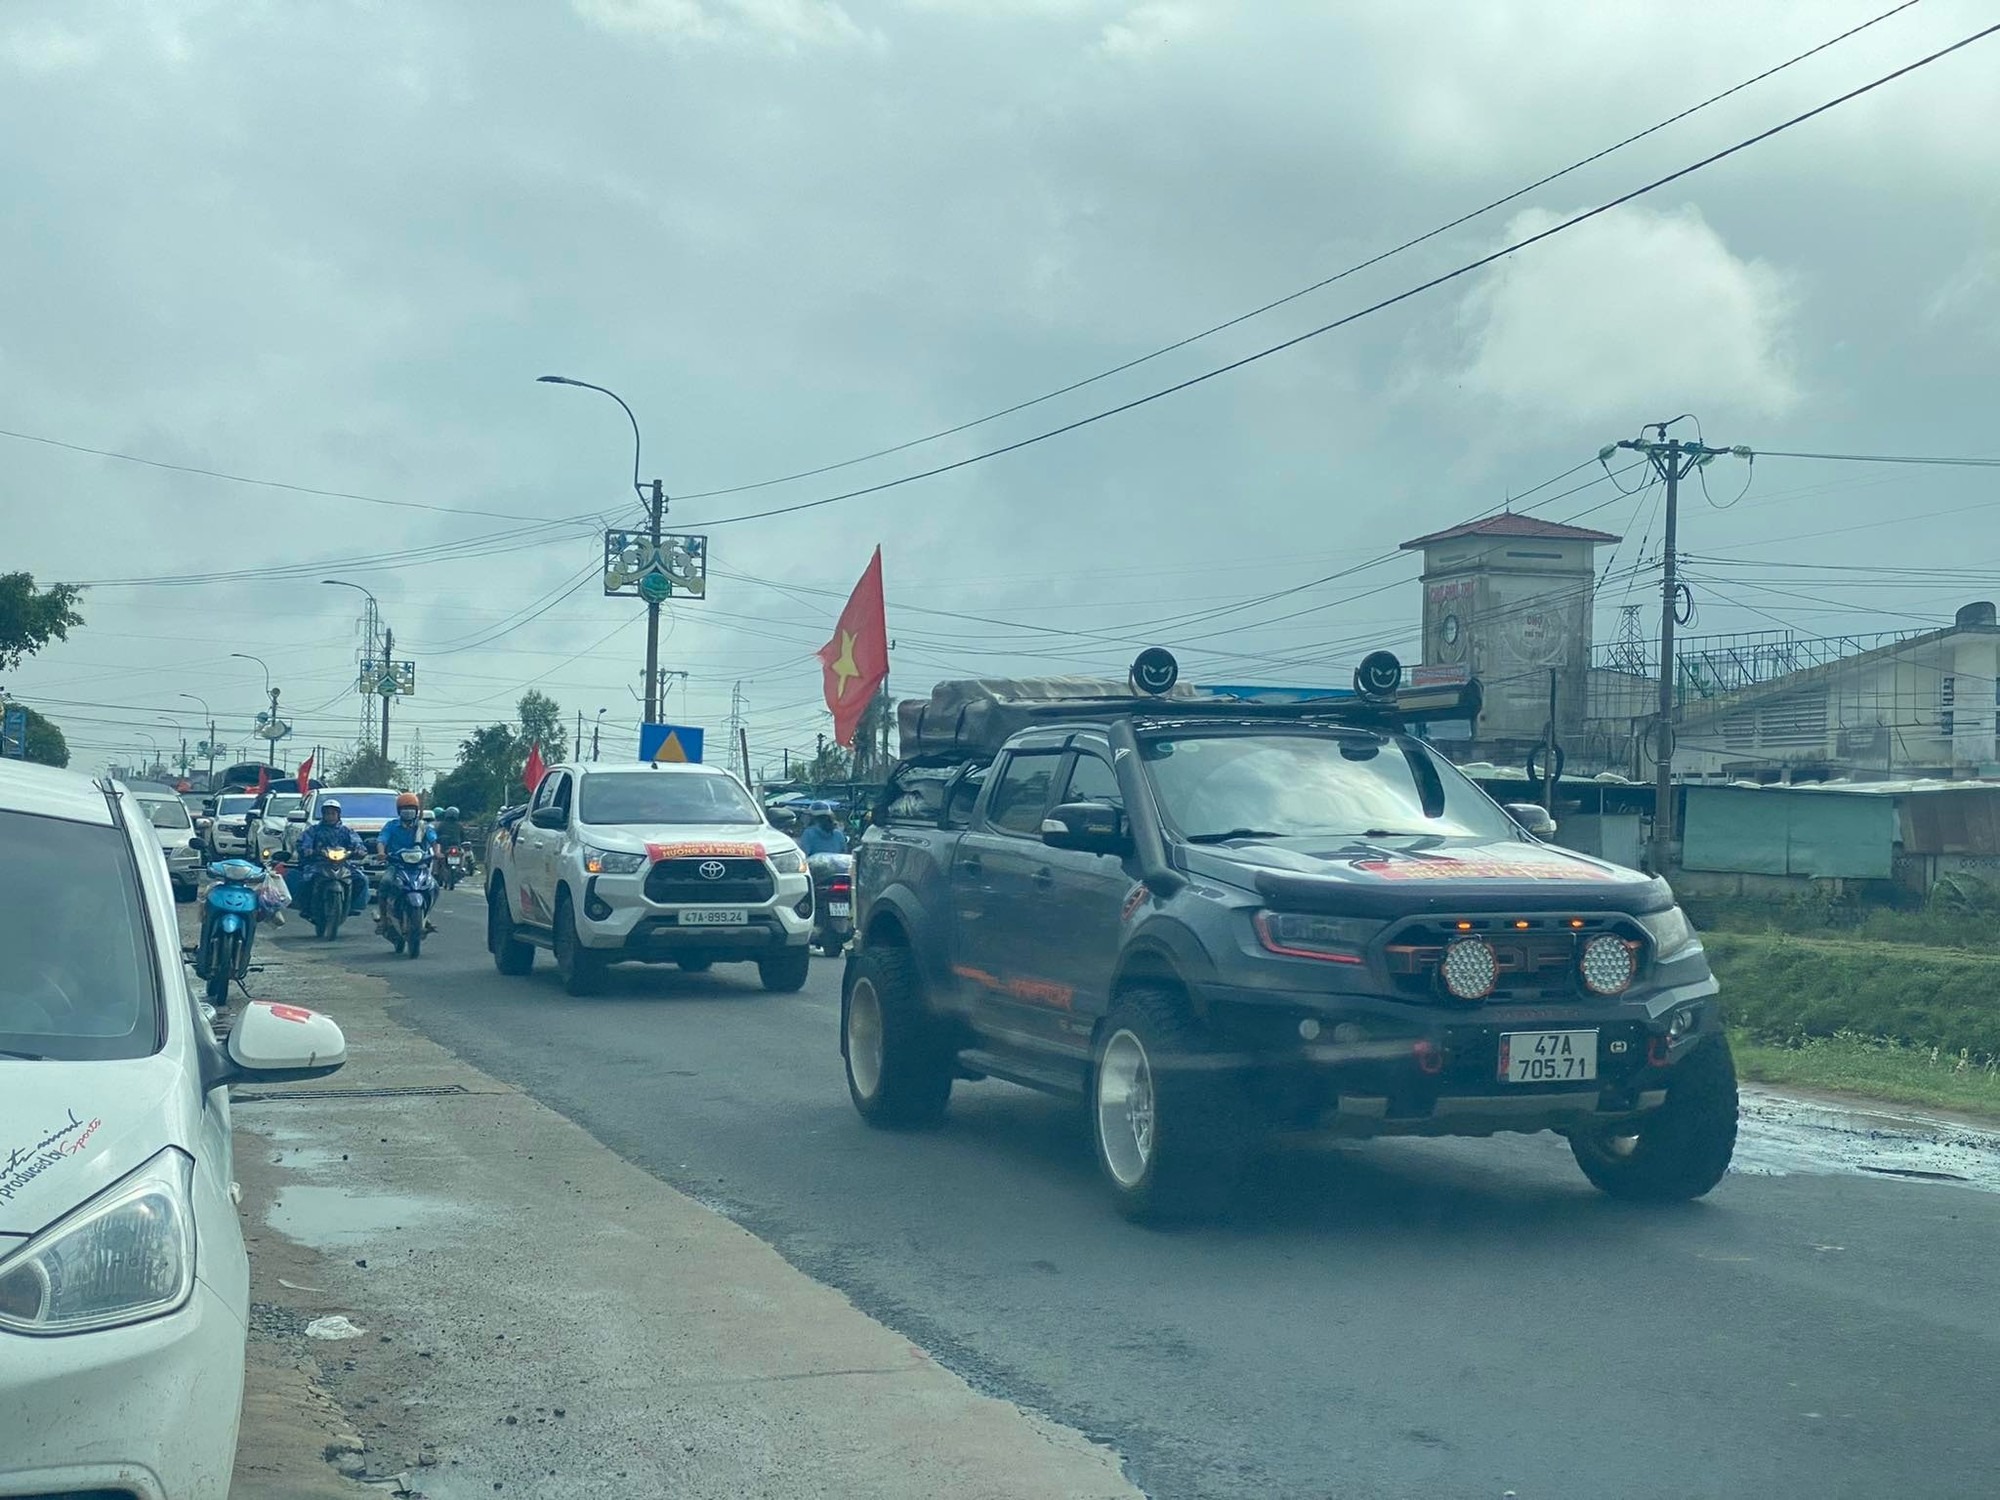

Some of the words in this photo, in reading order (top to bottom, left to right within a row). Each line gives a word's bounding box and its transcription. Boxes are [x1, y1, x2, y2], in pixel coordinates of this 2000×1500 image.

[1534, 1034, 1572, 1056] 47A
[1518, 1057, 1586, 1080] 705.71
[59, 1117, 102, 1155] Sports
[0, 1148, 37, 1181] orts
